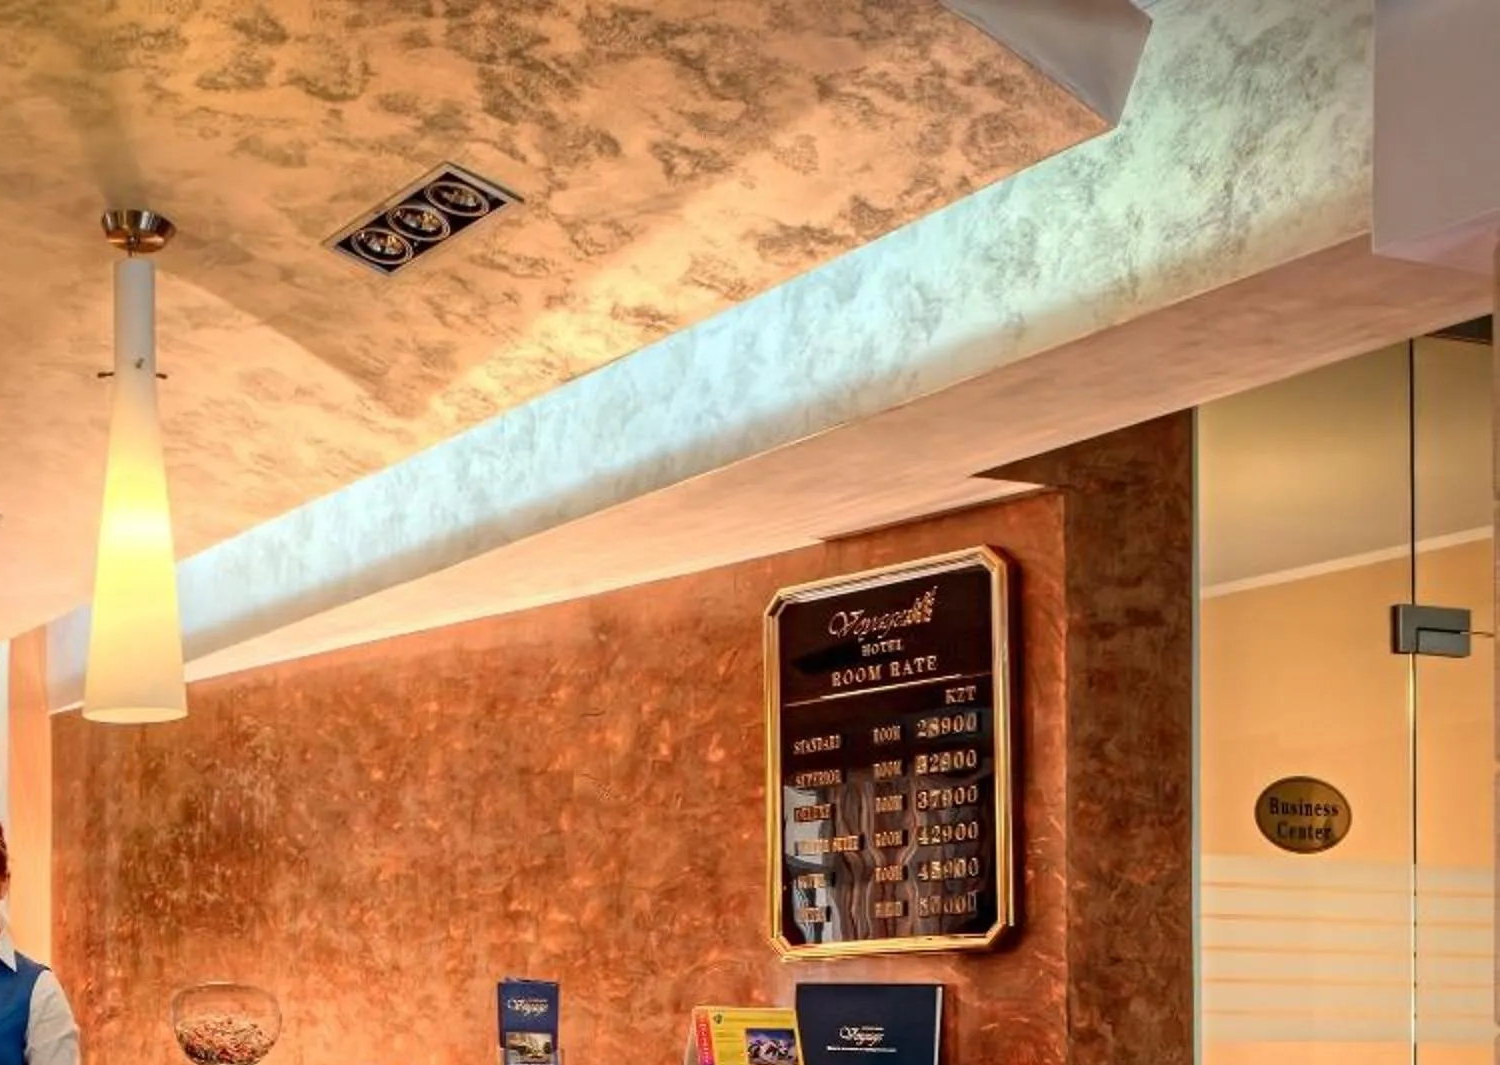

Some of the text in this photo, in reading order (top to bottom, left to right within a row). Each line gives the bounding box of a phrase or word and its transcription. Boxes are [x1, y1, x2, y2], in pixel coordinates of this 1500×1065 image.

[861, 639, 903, 657] HOTEL
[831, 655, 937, 687] ROOM RATE
[945, 685, 976, 704] KZT
[793, 734, 841, 755] STANDARD
[1269, 797, 1339, 817] Business
[918, 821, 978, 845] 42900
[1277, 821, 1332, 842] Center
